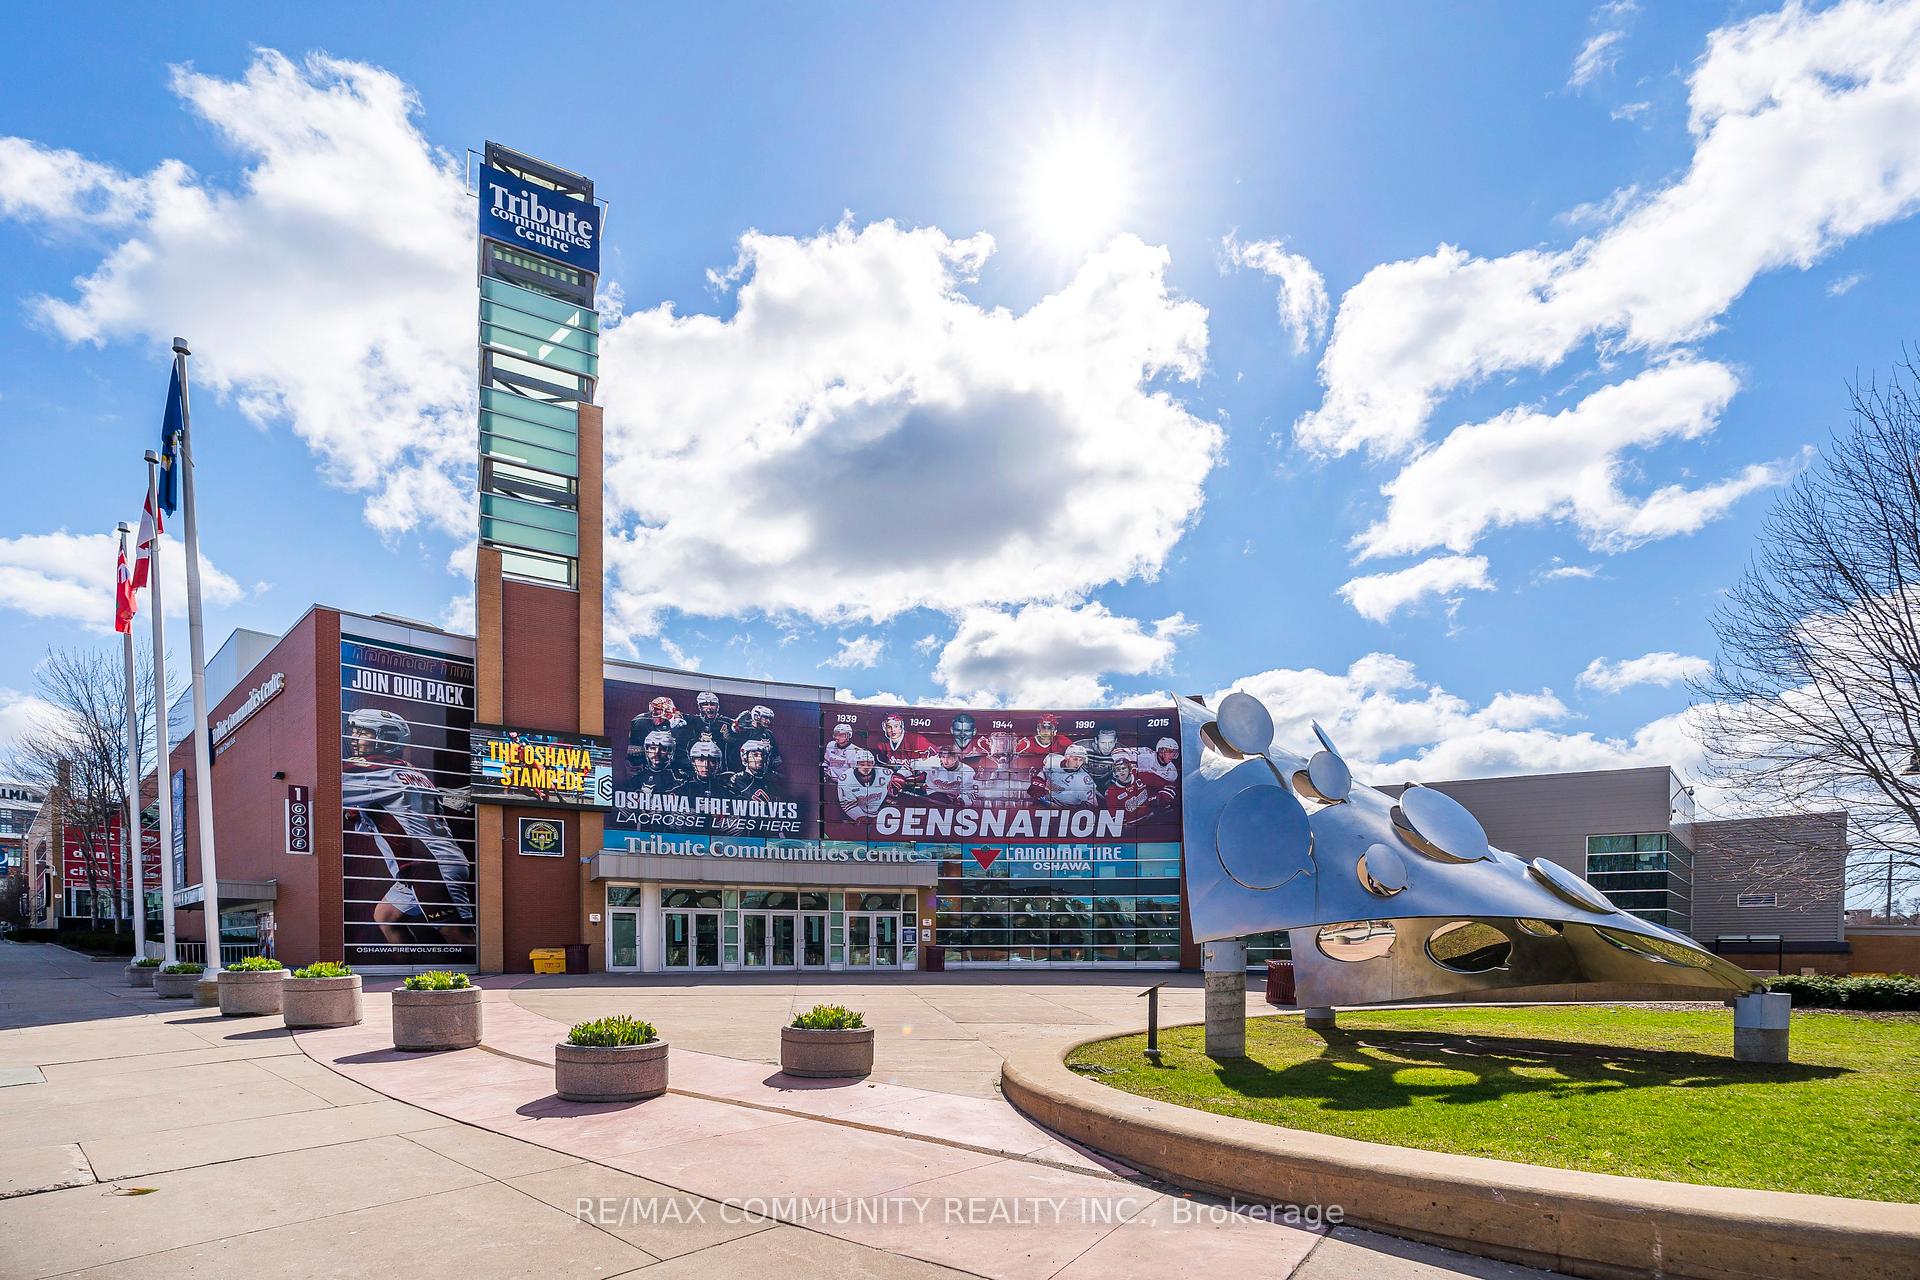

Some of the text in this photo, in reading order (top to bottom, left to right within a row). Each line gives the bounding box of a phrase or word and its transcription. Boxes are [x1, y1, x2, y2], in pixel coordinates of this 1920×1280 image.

[489, 182, 593, 240] Tribute
[515, 226, 569, 253] Centre
[352, 669, 464, 706] JOIN OUR PACK
[836, 714, 857, 723] 1939
[910, 718, 931, 727] 1940
[992, 720, 1013, 729] 1944
[1075, 720, 1095, 729] 1990
[1147, 718, 1169, 727] 2015
[488, 741, 592, 770] THE OSHAWA
[501, 765, 586, 792] STAMPEDE
[0, 788, 28, 801] LMA
[614, 790, 798, 819] OSHAWA FIREWOLVES
[293, 787, 304, 848] 1 GATE
[616, 812, 801, 833] LACROSSE LIVES HERE
[876, 807, 1125, 837] GENSNATION
[624, 835, 917, 863] Tribute Communities Centre
[1088, 846, 1122, 860] TIRE
[1032, 862, 1091, 871] OSHAWA
